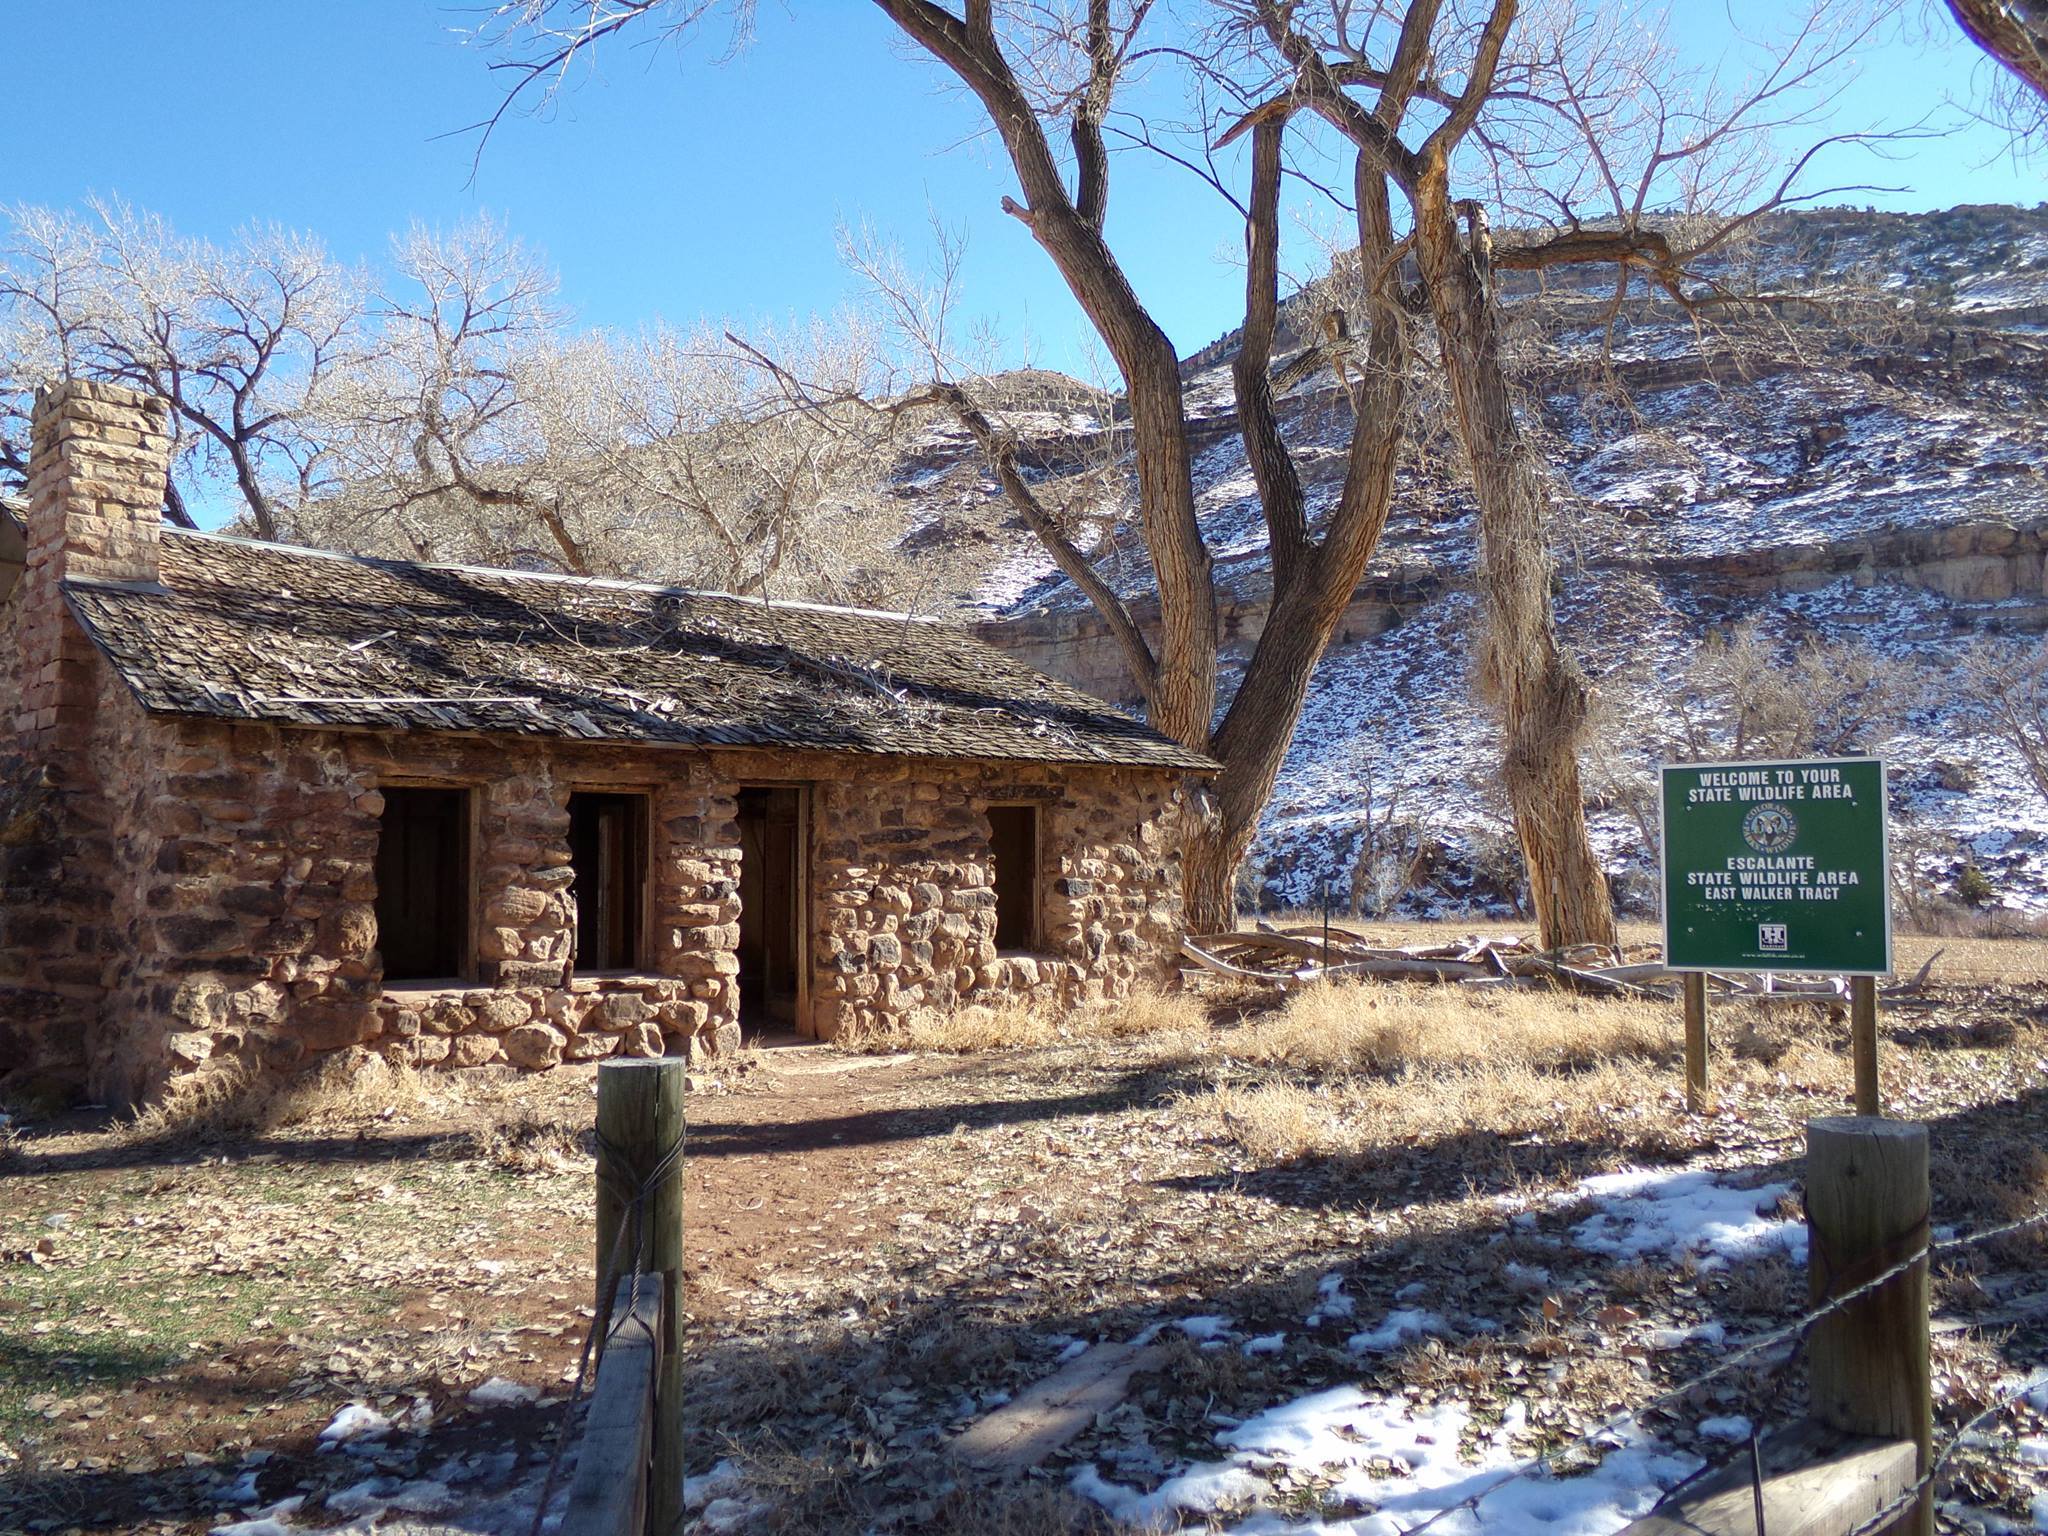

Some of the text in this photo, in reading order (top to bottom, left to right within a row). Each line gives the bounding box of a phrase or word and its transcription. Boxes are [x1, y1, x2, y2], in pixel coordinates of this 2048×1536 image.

[1700, 769, 1840, 787] WELCOME TO YOUR
[1689, 784, 1852, 802] STATE WILDLIFE AREA
[1746, 803, 1792, 820] COLORADO
[1727, 857, 1814, 870] ESCALANTE
[1687, 871, 1859, 885] STATE WILDLIFE AREA
[1705, 887, 1839, 900] EAST WALKER TRACT
